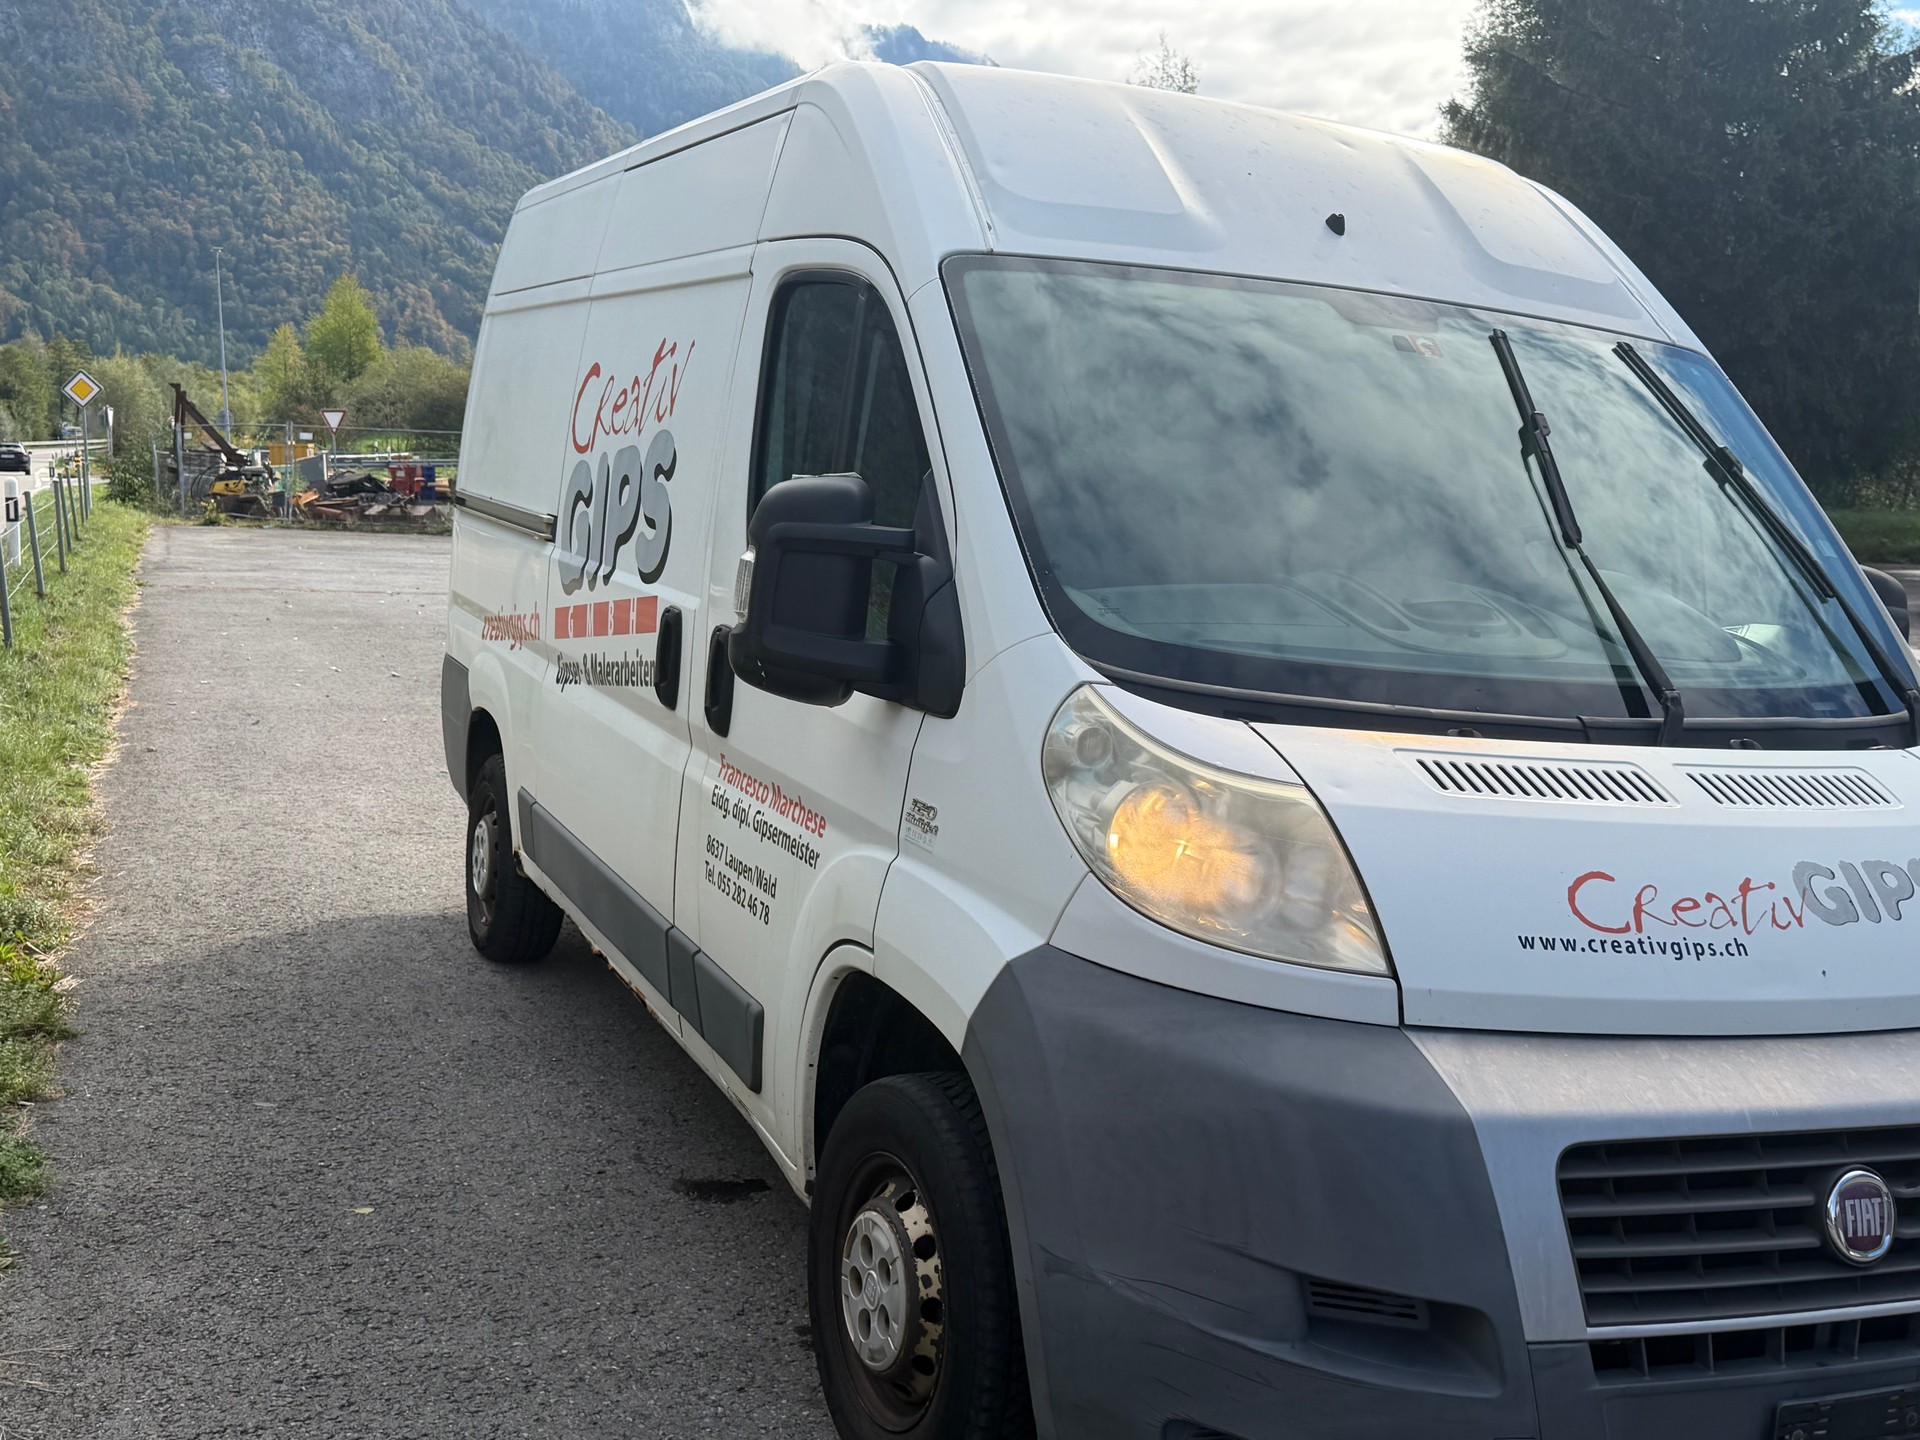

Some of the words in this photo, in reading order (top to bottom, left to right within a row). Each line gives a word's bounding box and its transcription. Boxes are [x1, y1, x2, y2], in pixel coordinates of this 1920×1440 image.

[572, 338, 696, 454] Creativ
[558, 429, 677, 596] GIPS
[482, 601, 541, 650] creativgips.ch
[583, 653, 592, 686] &
[591, 648, 656, 687] Malerarbeiten
[711, 785, 731, 819] Eidg.
[732, 797, 751, 829] dipl.
[752, 810, 821, 869] Gipsermeister
[717, 753, 770, 804] Francesco
[769, 782, 827, 838] Marchese
[704, 860, 716, 886] Tel.
[717, 870, 731, 897] 055
[732, 881, 746, 909] 282
[747, 893, 758, 917] 46
[759, 901, 770, 926] 78
[706, 834, 724, 860] 8637
[724, 846, 777, 900] Laupen/Wald
[1567, 871, 1807, 935] Creativ
[1518, 934, 1750, 961] www.creativgips.ch
[1844, 1197, 1882, 1238] FIAT
